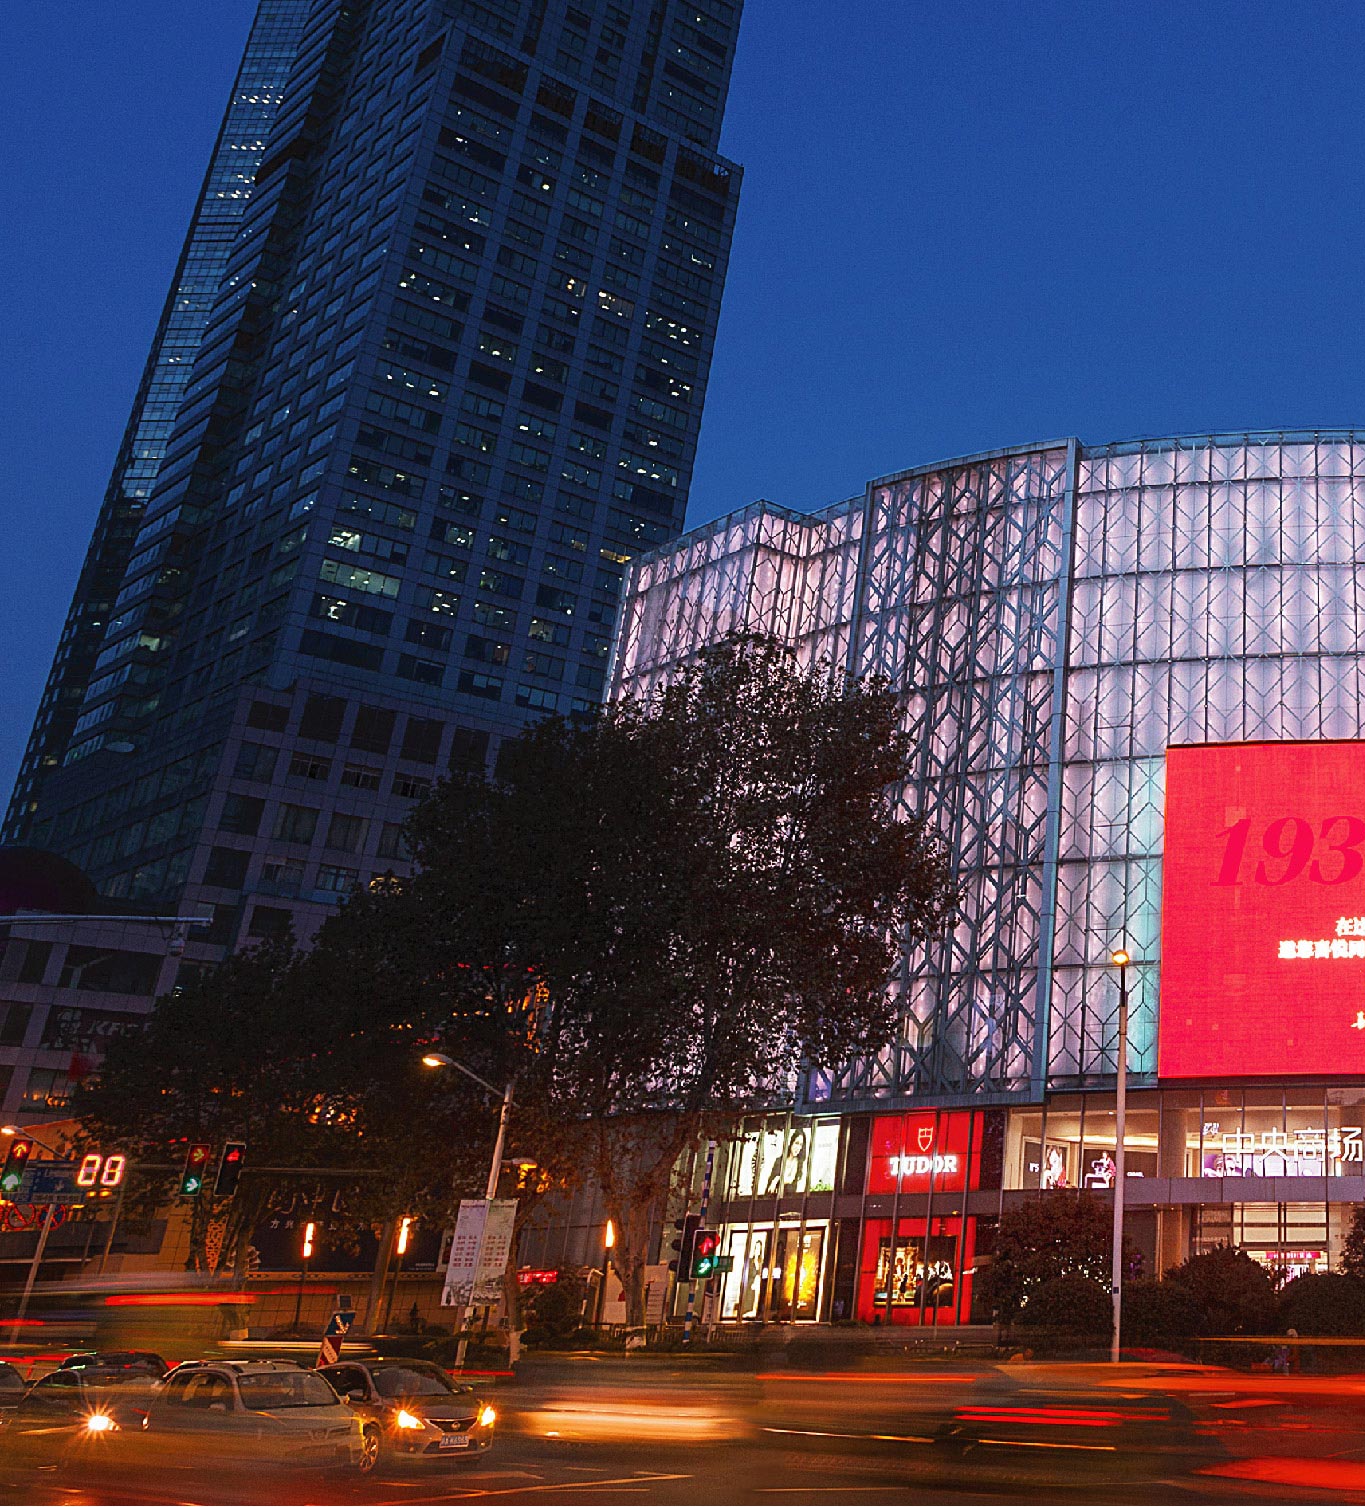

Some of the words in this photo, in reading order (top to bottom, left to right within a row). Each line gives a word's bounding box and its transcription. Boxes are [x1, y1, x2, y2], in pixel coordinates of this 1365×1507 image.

[1222, 1126, 1364, 1165] 中央商场
[889, 1155, 958, 1176] TUDOR
